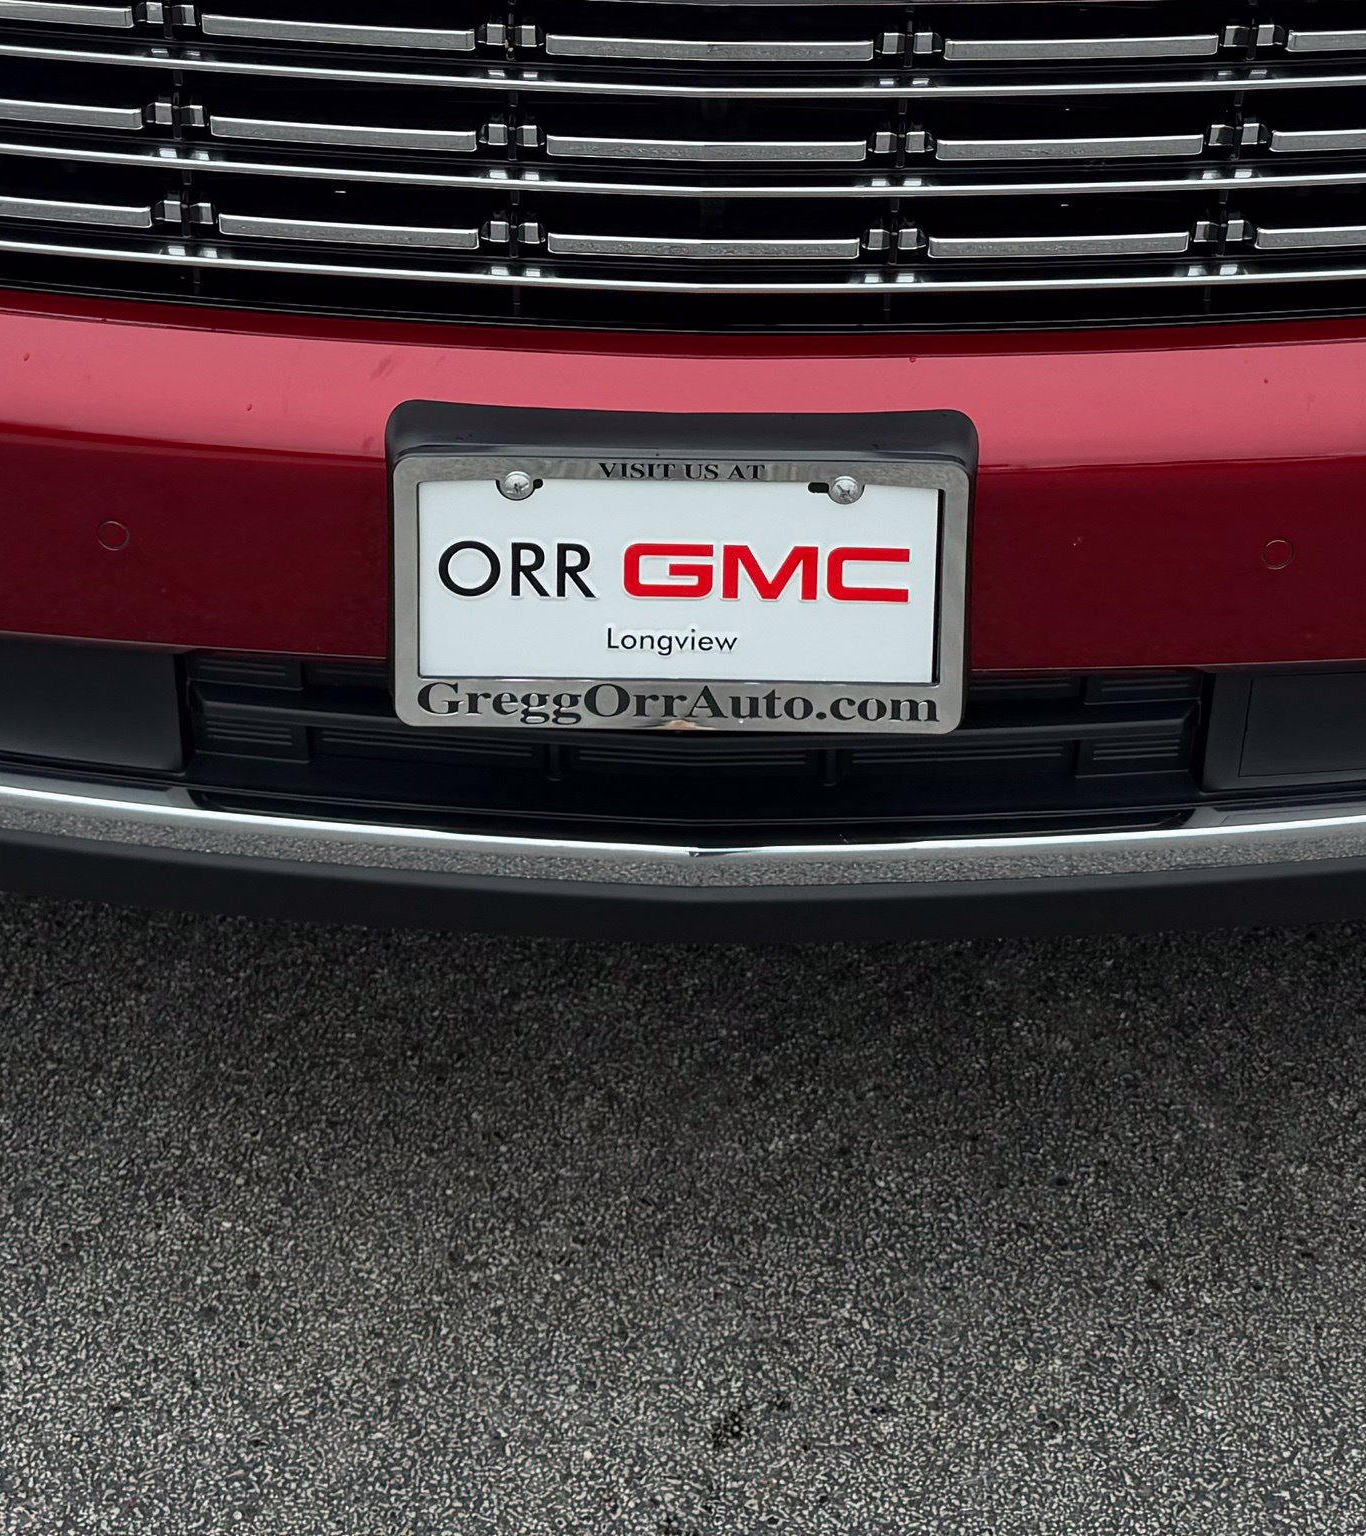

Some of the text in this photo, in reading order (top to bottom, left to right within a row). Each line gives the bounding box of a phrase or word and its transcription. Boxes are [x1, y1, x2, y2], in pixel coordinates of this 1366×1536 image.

[598, 462, 766, 480] VISIT US AT
[438, 540, 911, 604] ORR GMC
[606, 627, 738, 656] Longview
[417, 681, 940, 726] GreggOrrAuto.com
